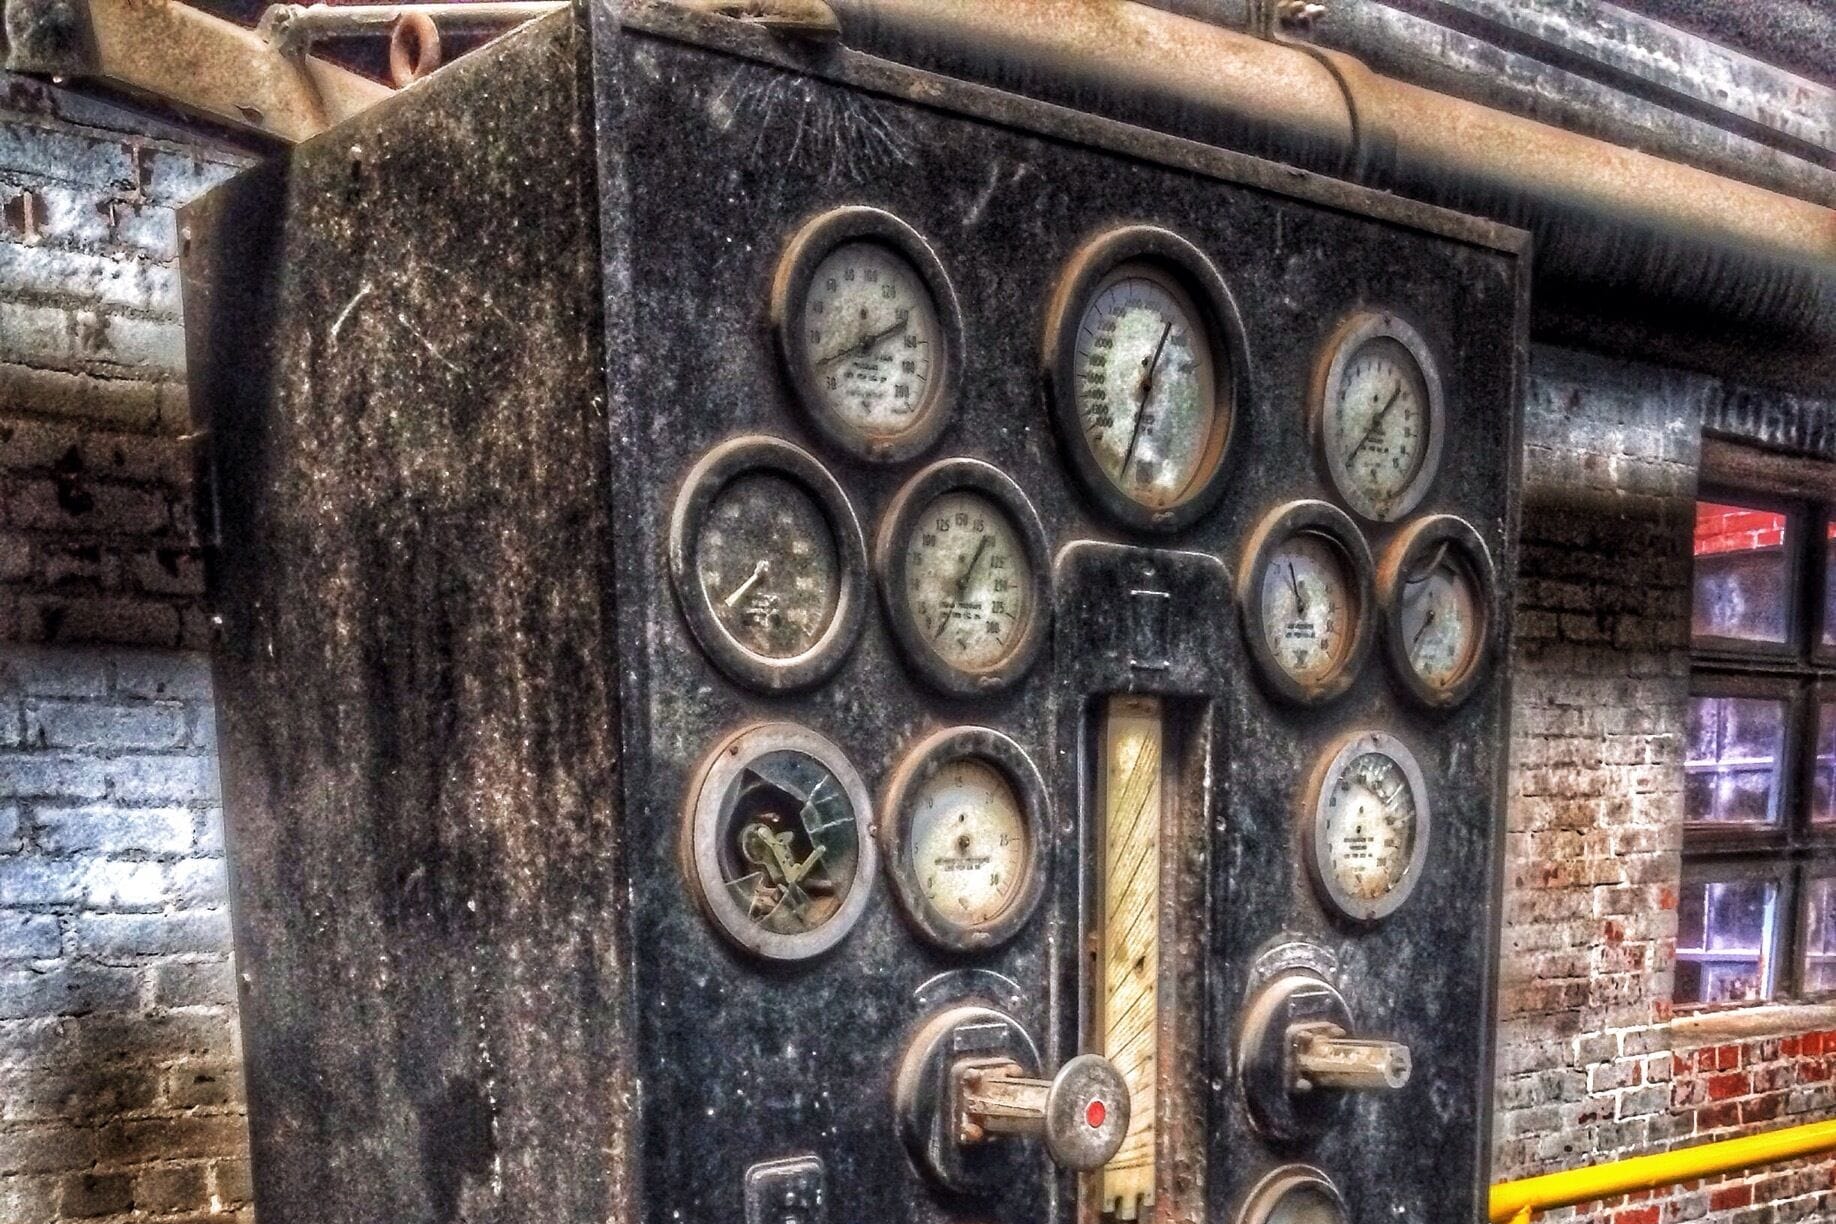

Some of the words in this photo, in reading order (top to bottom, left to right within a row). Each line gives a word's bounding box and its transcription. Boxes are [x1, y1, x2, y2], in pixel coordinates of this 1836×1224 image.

[936, 519, 950, 532] 125
[955, 513, 969, 526] 150
[922, 534, 936, 547] 100
[999, 834, 1009, 847] 25
[990, 873, 999, 886] 30
